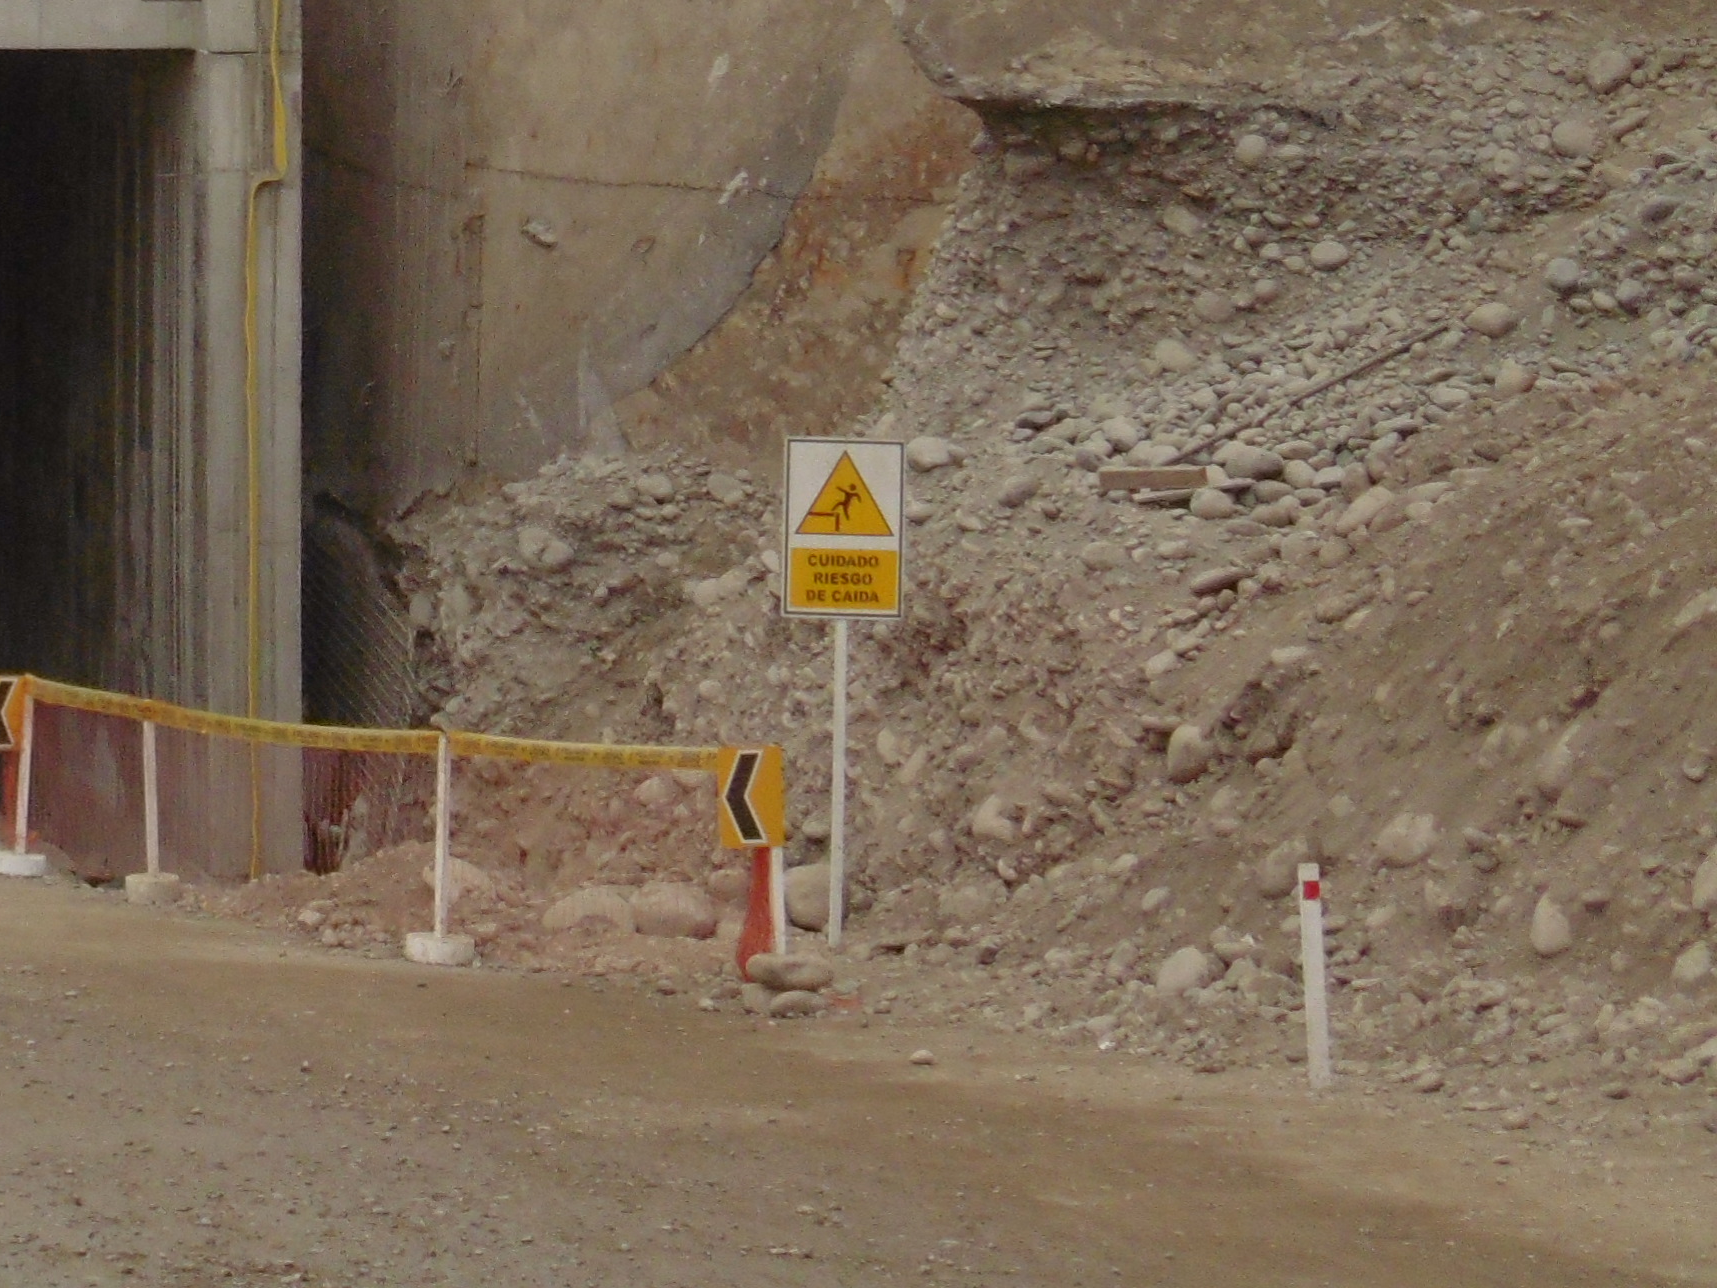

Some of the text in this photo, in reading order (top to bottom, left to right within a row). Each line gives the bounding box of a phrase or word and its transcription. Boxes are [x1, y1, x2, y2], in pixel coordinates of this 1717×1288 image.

[807, 554, 879, 567] CUIDADO
[814, 572, 873, 585] RIESGO
[806, 589, 880, 603] DE CAIDA
